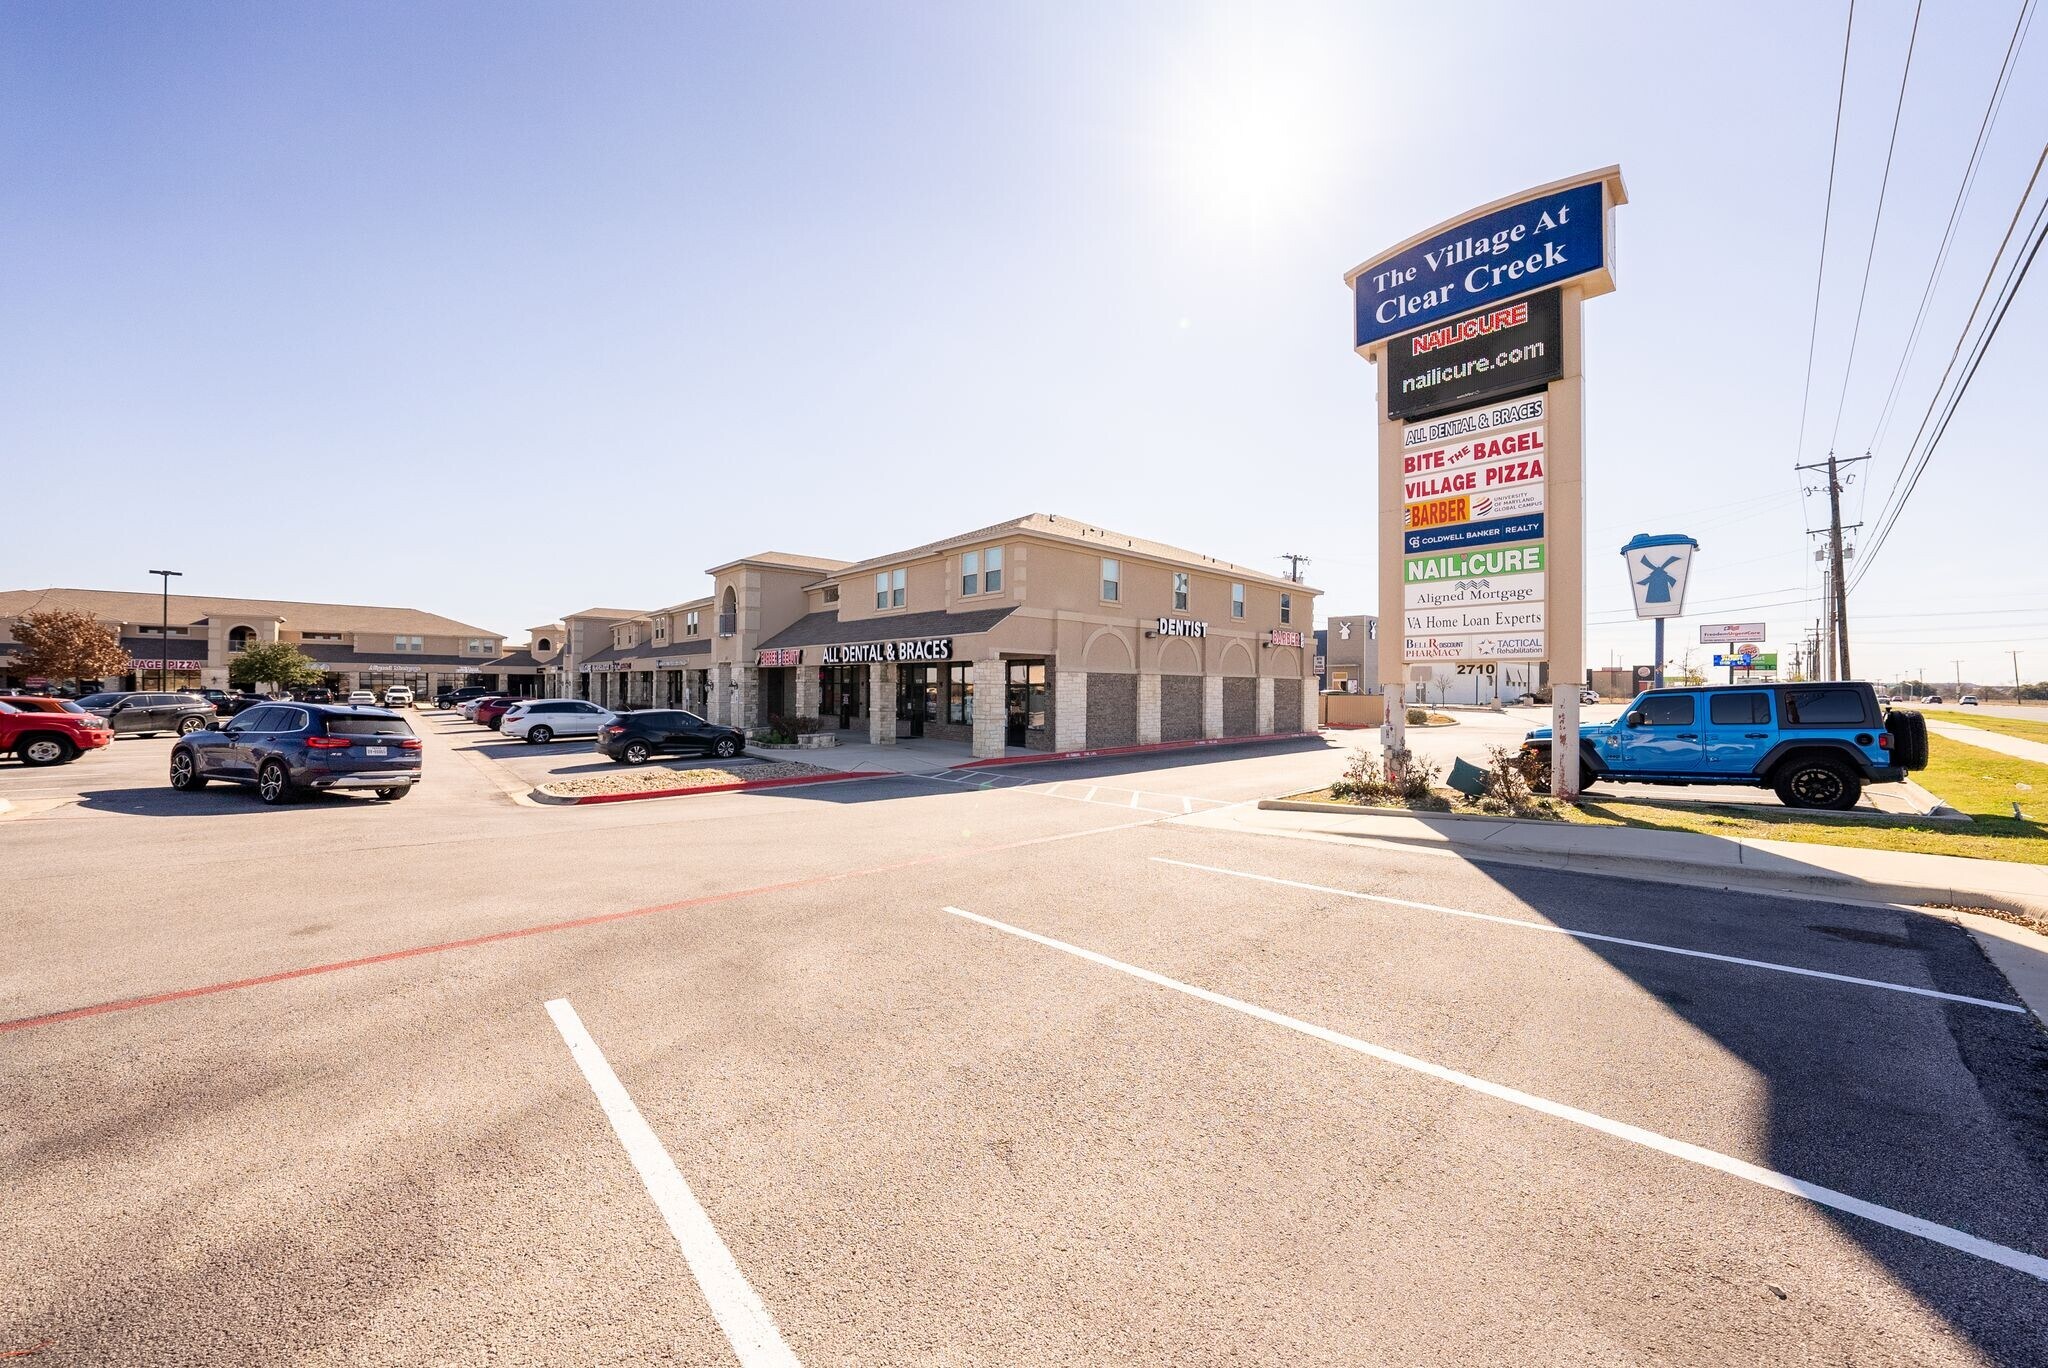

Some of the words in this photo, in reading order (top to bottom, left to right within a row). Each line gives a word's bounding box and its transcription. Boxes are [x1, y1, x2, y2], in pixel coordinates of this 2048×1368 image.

[1373, 264, 1417, 294] The
[1423, 224, 1526, 273] Village
[1532, 204, 1570, 235] At
[1375, 283, 1455, 324] Clear
[1463, 241, 1568, 293] Creek
[1412, 301, 1528, 356] NAILICURE
[1402, 341, 1545, 393] nailicure.com
[1405, 427, 1427, 446] ALL
[1429, 418, 1476, 441] DENTAL
[1478, 413, 1490, 429] &
[1492, 400, 1543, 426] BRACES
[1404, 450, 1445, 474] BITE
[1448, 445, 1471, 465] THE
[1473, 432, 1544, 460] BAGEL
[1405, 472, 1476, 499] VILLAGE
[1485, 459, 1543, 486] PIZZA
[1493, 492, 1528, 502] UNIVERSITY
[1493, 504, 1517, 513] GLOBAL
[1517, 500, 1543, 509] CAMPUS
[1503, 496, 1535, 506] MARYLAND
[1411, 498, 1466, 528] BARBER
[1422, 533, 1465, 545] COLDWELL
[1466, 528, 1500, 539] BANKER
[1505, 523, 1540, 534] REALTY
[1417, 590, 1464, 606] Aligned
[1470, 587, 1533, 601] Mortgage
[1159, 618, 1209, 638] DENTIST
[1407, 616, 1422, 630] VA
[1426, 615, 1458, 630] Home
[1462, 613, 1490, 627] Loan
[1495, 611, 1542, 627] Experts
[1272, 630, 1300, 646] BARBER
[1497, 638, 1543, 648] TACTICAL
[822, 647, 839, 663] ALL
[842, 644, 883, 662] DENTAL
[886, 643, 896, 660] &
[899, 639, 948, 660] BRACES
[1406, 649, 1462, 658] PHARMACY
[1496, 647, 1543, 655] Rehabilitation
[168, 660, 201, 669] PIZZA
[1457, 664, 1495, 675] 2710
